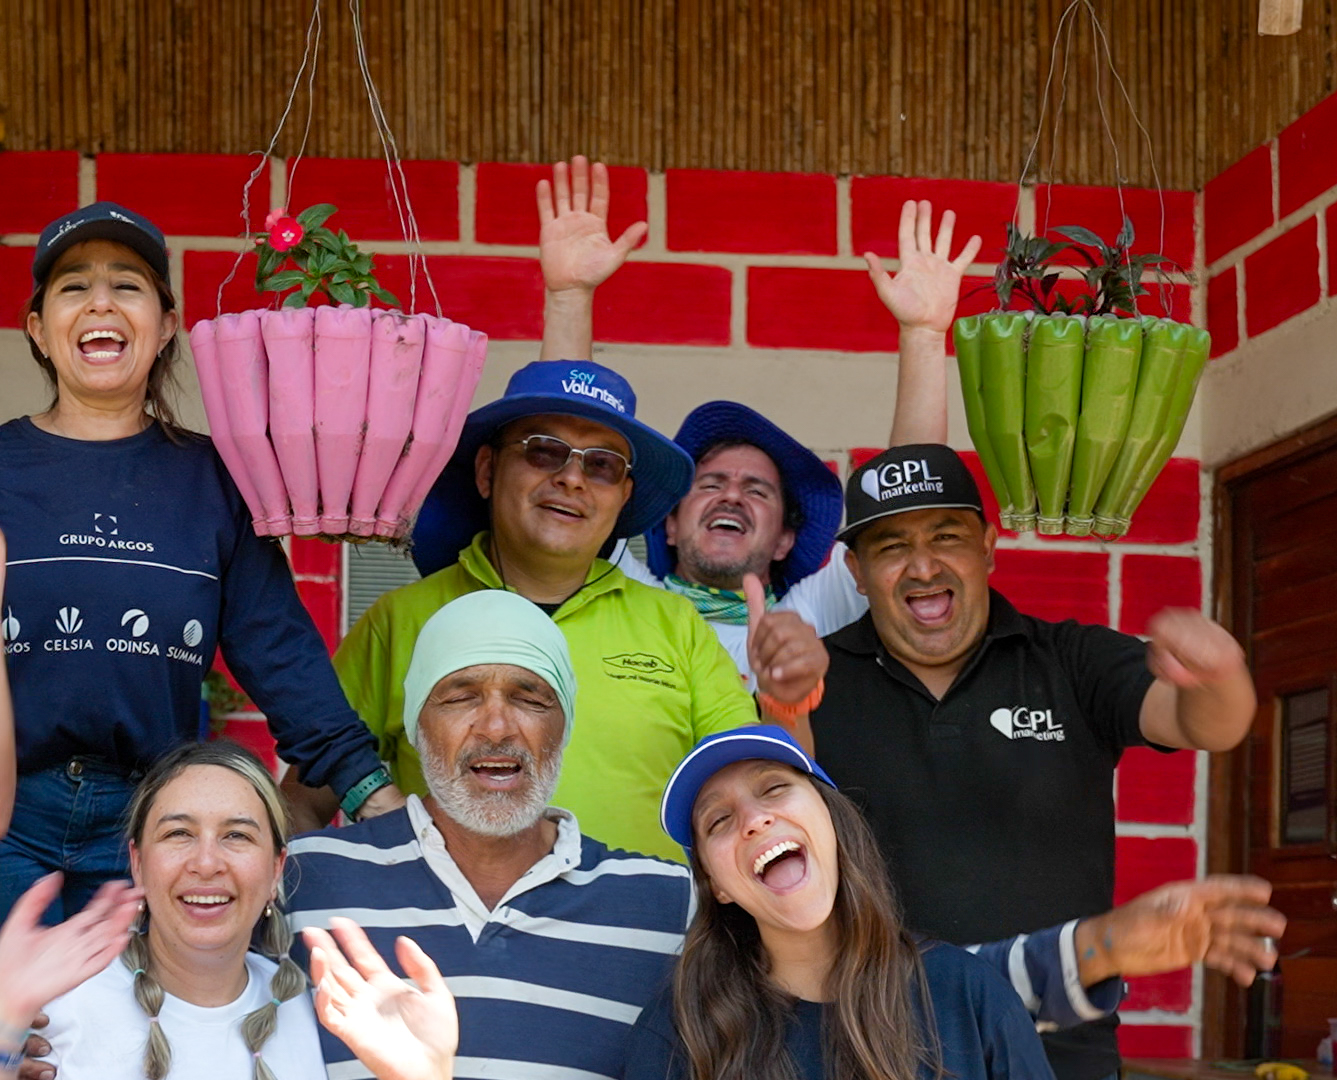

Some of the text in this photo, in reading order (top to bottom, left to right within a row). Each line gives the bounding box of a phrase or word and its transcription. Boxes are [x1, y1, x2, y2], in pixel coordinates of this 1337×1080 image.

[879, 459, 942, 488] GPL
[880, 480, 944, 501] marketing
[59, 534, 154, 552] GRUPO ARGOS
[43, 639, 94, 651] CELSIA
[106, 638, 160, 656] ODINSA
[166, 646, 203, 665] SUMMA
[1012, 706, 1063, 731] GPL
